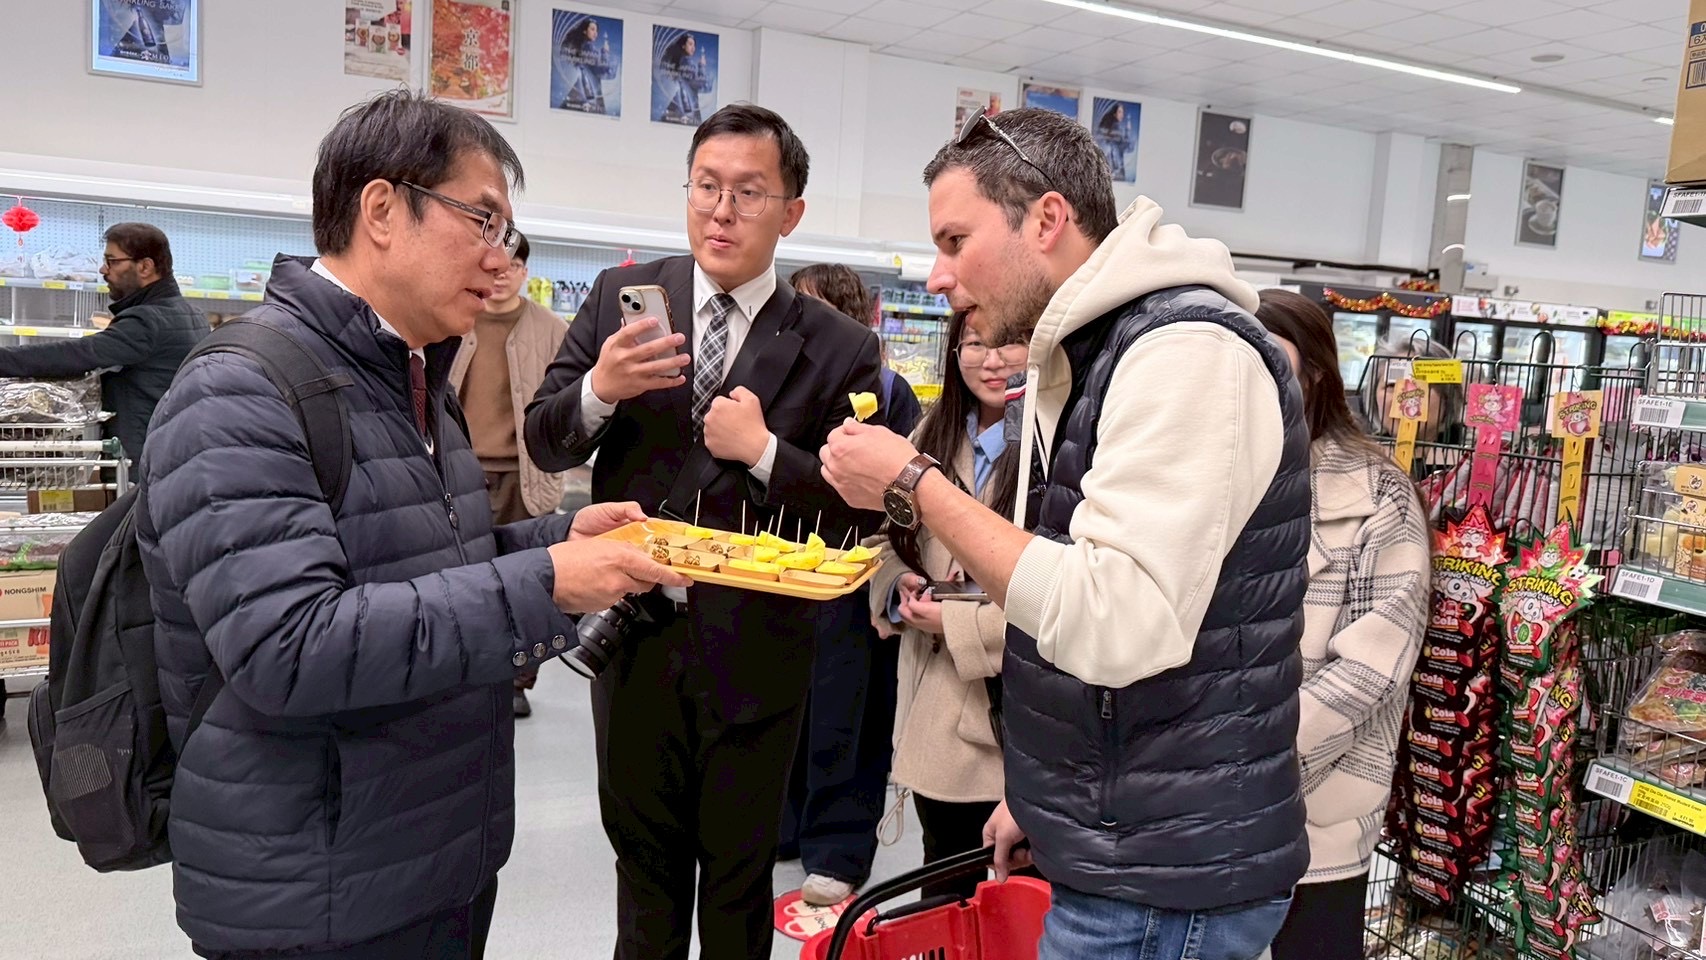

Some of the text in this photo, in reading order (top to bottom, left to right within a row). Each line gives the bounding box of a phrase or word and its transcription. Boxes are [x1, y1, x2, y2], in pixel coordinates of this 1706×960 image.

[1558, 401, 1598, 420] STRIKING
[1432, 556, 1503, 587] TRIKING
[1621, 571, 1655, 583] SFAFE1-1D
[4, 586, 47, 595] NONGSHIM
[1508, 576, 1575, 608] STRIKING
[1431, 646, 1457, 657] Cola
[1420, 672, 1444, 685] Cola
[1431, 707, 1456, 717] Cola
[1413, 731, 1438, 745] Cola
[1415, 762, 1440, 775] Cola
[1595, 767, 1628, 783] SFAFE1-1C
[1420, 793, 1443, 806] Cola
[1422, 823, 1447, 836] Cola
[1420, 850, 1444, 863] Cola
[1412, 873, 1436, 889] Cola
